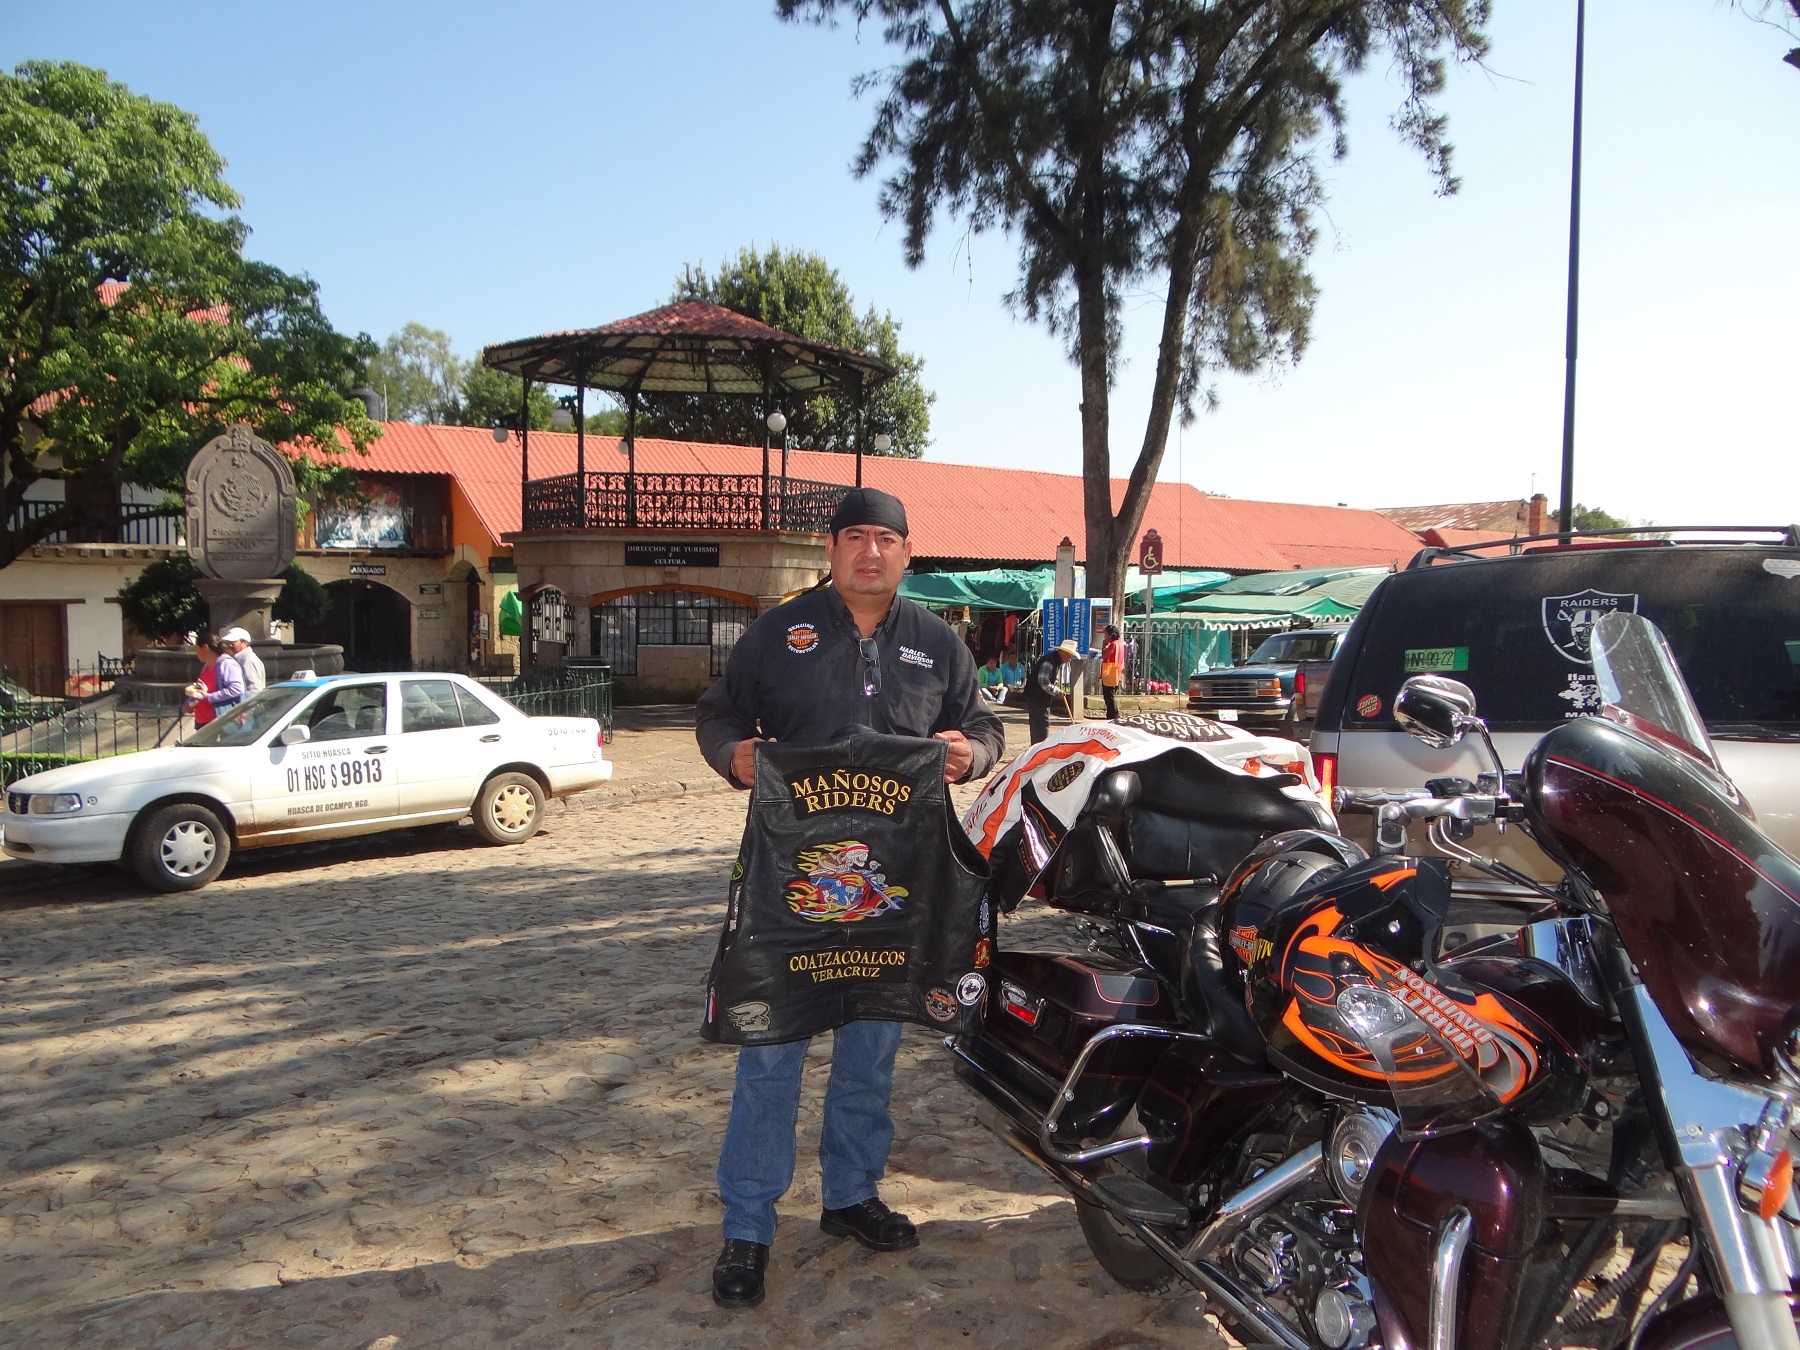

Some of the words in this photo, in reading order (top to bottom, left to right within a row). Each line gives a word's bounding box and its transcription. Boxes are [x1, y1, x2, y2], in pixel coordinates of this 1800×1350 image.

[1560, 598, 1618, 607] RAIDERS
[902, 652, 935, 665] DAVIDSON
[1357, 695, 1378, 711] SANTA
[1361, 702, 1378, 716] CRUZ
[1117, 714, 1224, 739] MAÑOSOS
[302, 750, 321, 760] SITIO
[323, 747, 352, 759] HUASCA
[287, 767, 300, 793] 01
[304, 764, 326, 791] HSC
[331, 763, 338, 789] S
[340, 758, 383, 787] 9813
[791, 769, 911, 802] MAÑOSOS
[287, 804, 315, 816] HUASCA
[315, 802, 325, 813] DE
[804, 791, 896, 815] RIDERS
[789, 950, 905, 972] COATZACOALCOS
[811, 966, 881, 983] VERACRUZ
[1390, 967, 1496, 1045] DAVIDSON
